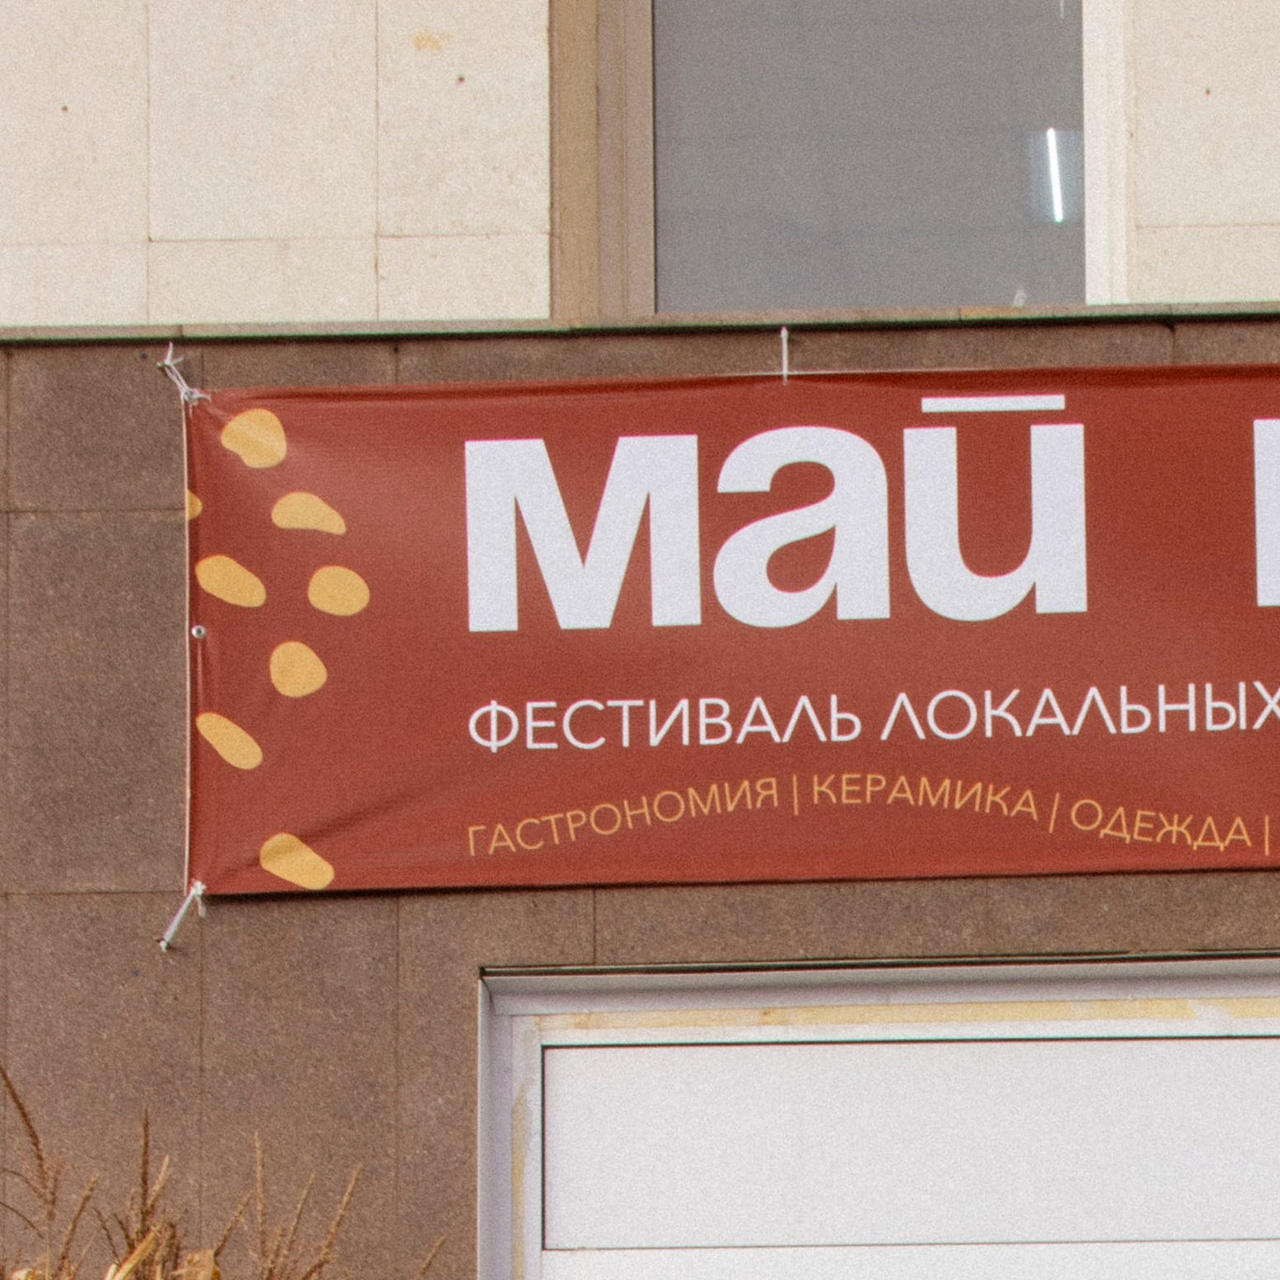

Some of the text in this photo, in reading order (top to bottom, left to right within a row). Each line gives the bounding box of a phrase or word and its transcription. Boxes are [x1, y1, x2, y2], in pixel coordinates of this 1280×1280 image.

[467, 693, 862, 752] ФЕСТИВАЛЬ
[467, 776, 779, 857] ГАСТРОНОМИЯ
[811, 772, 1039, 821] КЕРАМИКА
[1069, 798, 1252, 853] ОДЕЖДА
